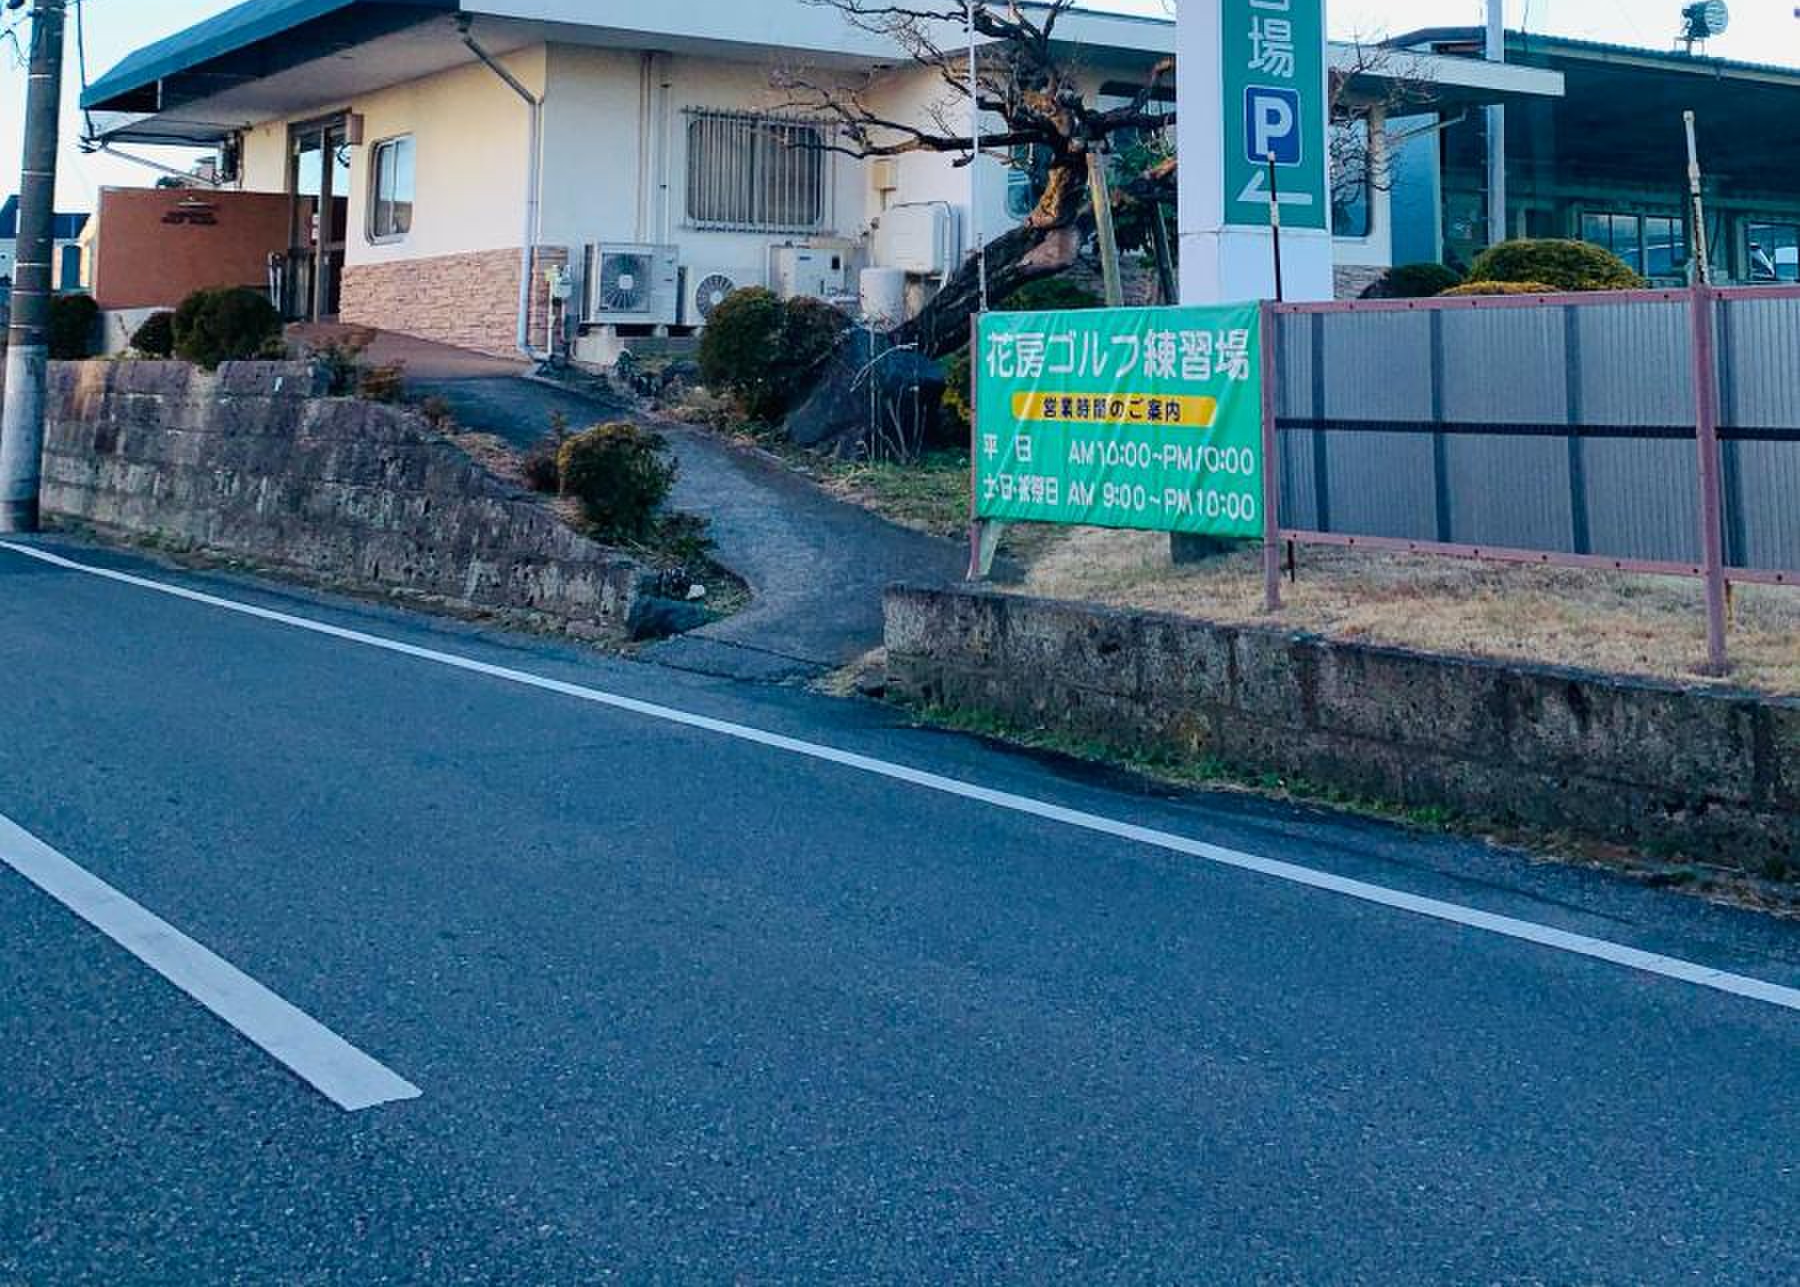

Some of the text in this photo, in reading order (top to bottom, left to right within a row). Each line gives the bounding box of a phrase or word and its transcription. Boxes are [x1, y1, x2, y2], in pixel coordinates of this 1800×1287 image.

[1254, 95, 1293, 156] P
[986, 329, 1249, 381] 花房ゴルフ練習場
[1042, 396, 1181, 422] 営業時間のご案内
